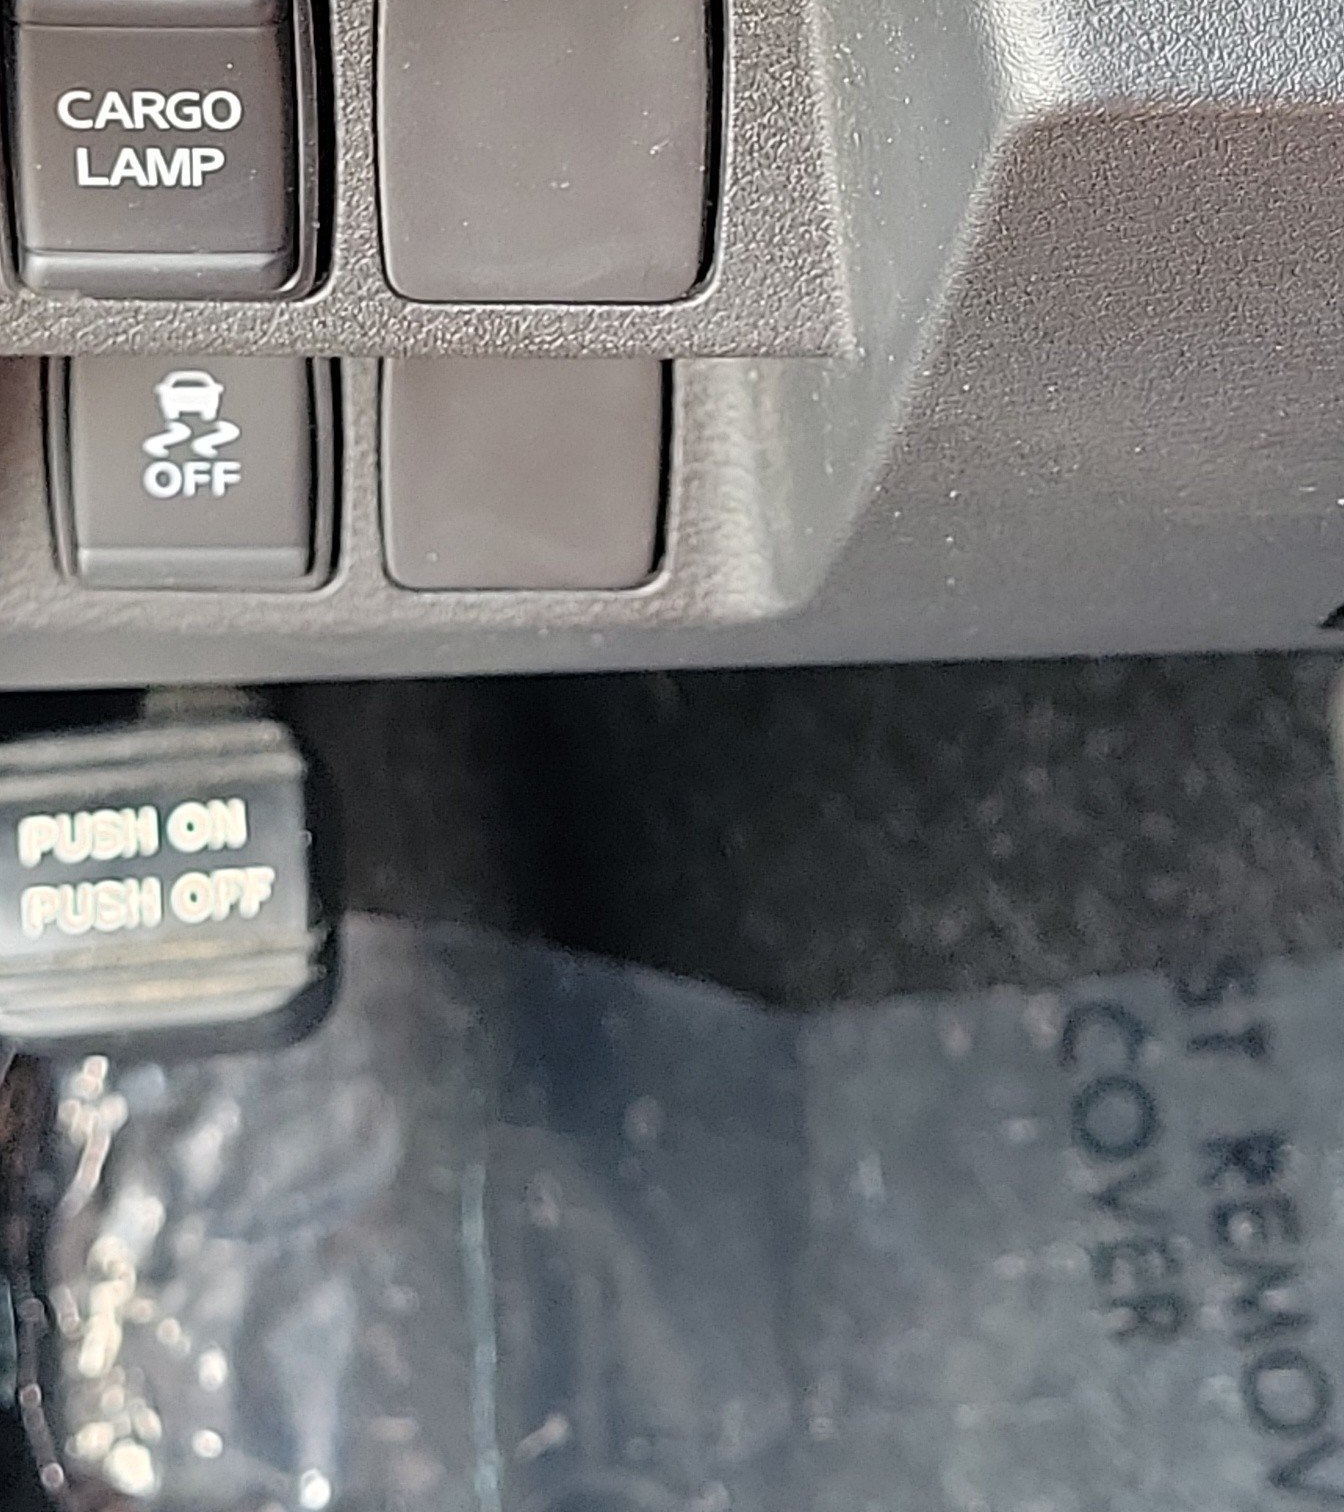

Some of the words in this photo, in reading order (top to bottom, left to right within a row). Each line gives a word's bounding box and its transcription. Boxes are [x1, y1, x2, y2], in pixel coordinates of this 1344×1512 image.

[57, 89, 243, 130] CARGO
[75, 146, 226, 187] LAMP
[142, 460, 243, 499] OFF
[17, 805, 159, 868] PUSH
[166, 797, 248, 853] ON
[20, 876, 162, 938] PUSH
[170, 865, 276, 923] OFF
[1058, 996, 1188, 1350] COVER
